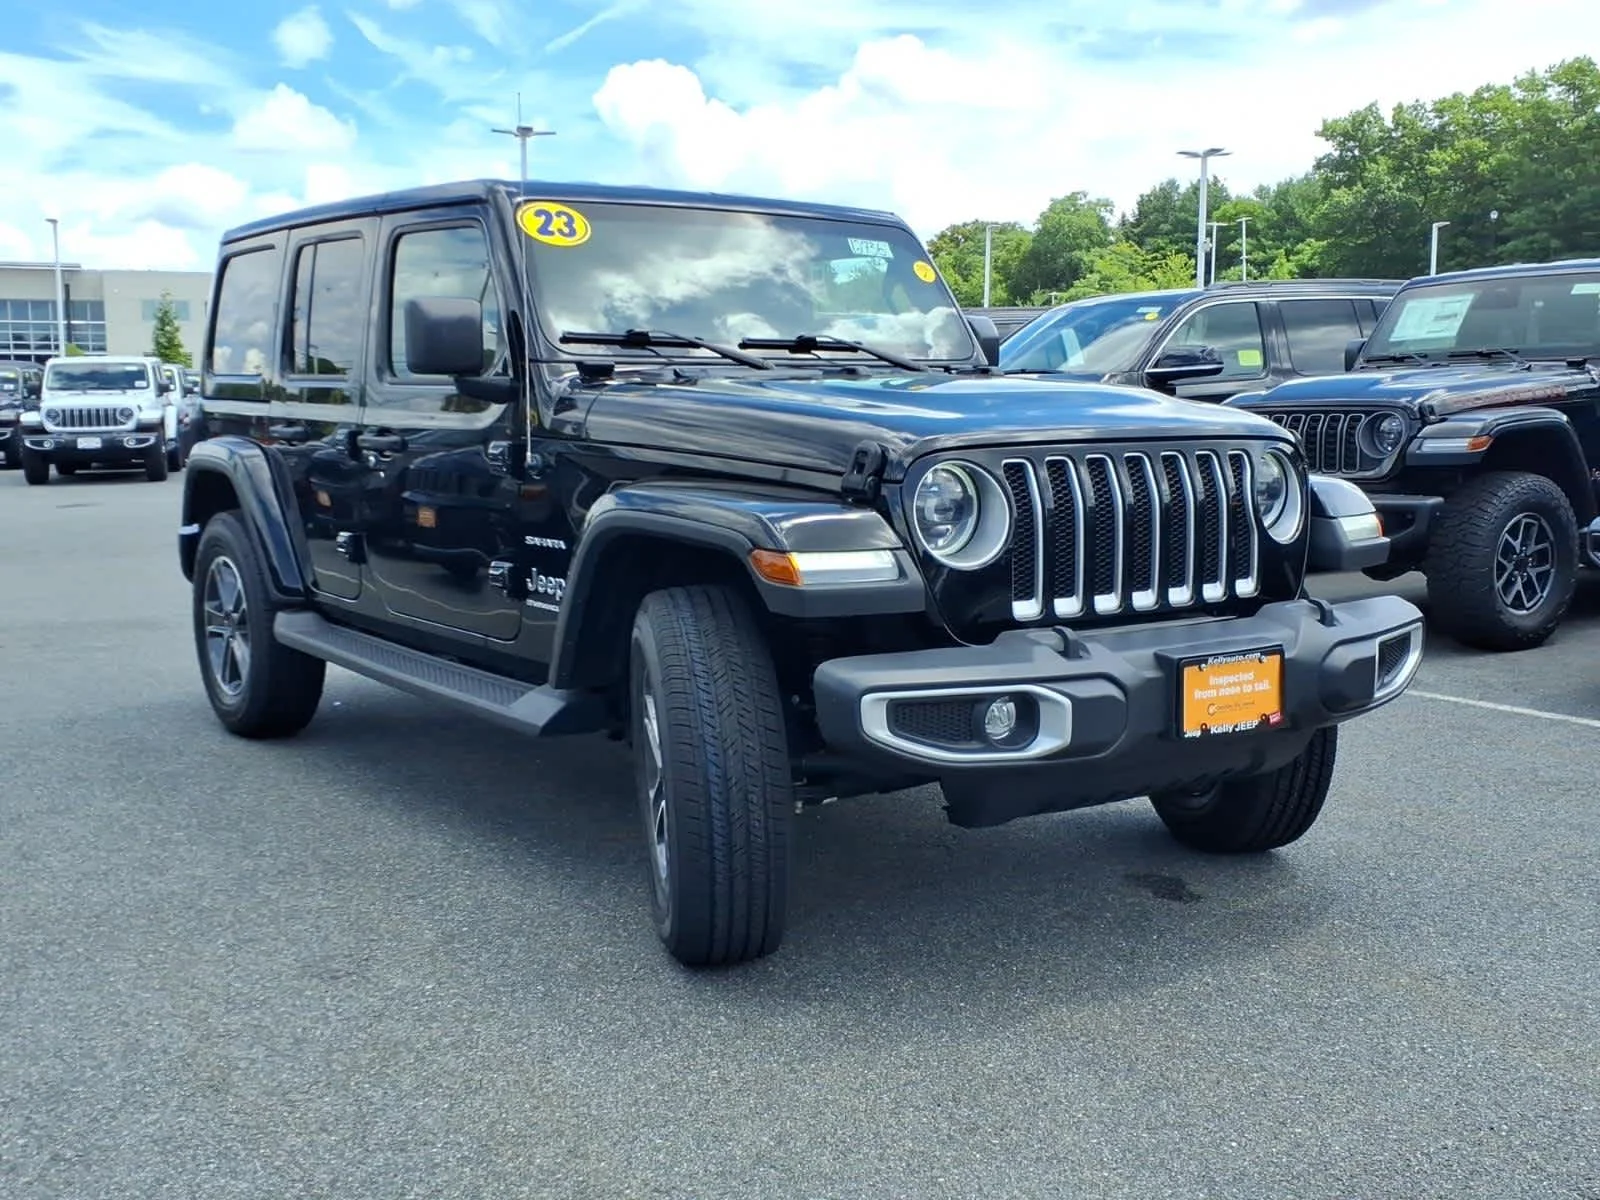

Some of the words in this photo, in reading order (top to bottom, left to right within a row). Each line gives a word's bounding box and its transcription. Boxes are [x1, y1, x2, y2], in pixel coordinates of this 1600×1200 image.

[534, 209, 577, 238] 23
[525, 567, 566, 601] Jeep
[1194, 688, 1217, 700] from
[1242, 683, 1253, 693] to
[1210, 722, 1234, 734] Kelly
[1234, 718, 1259, 732] JEEP
